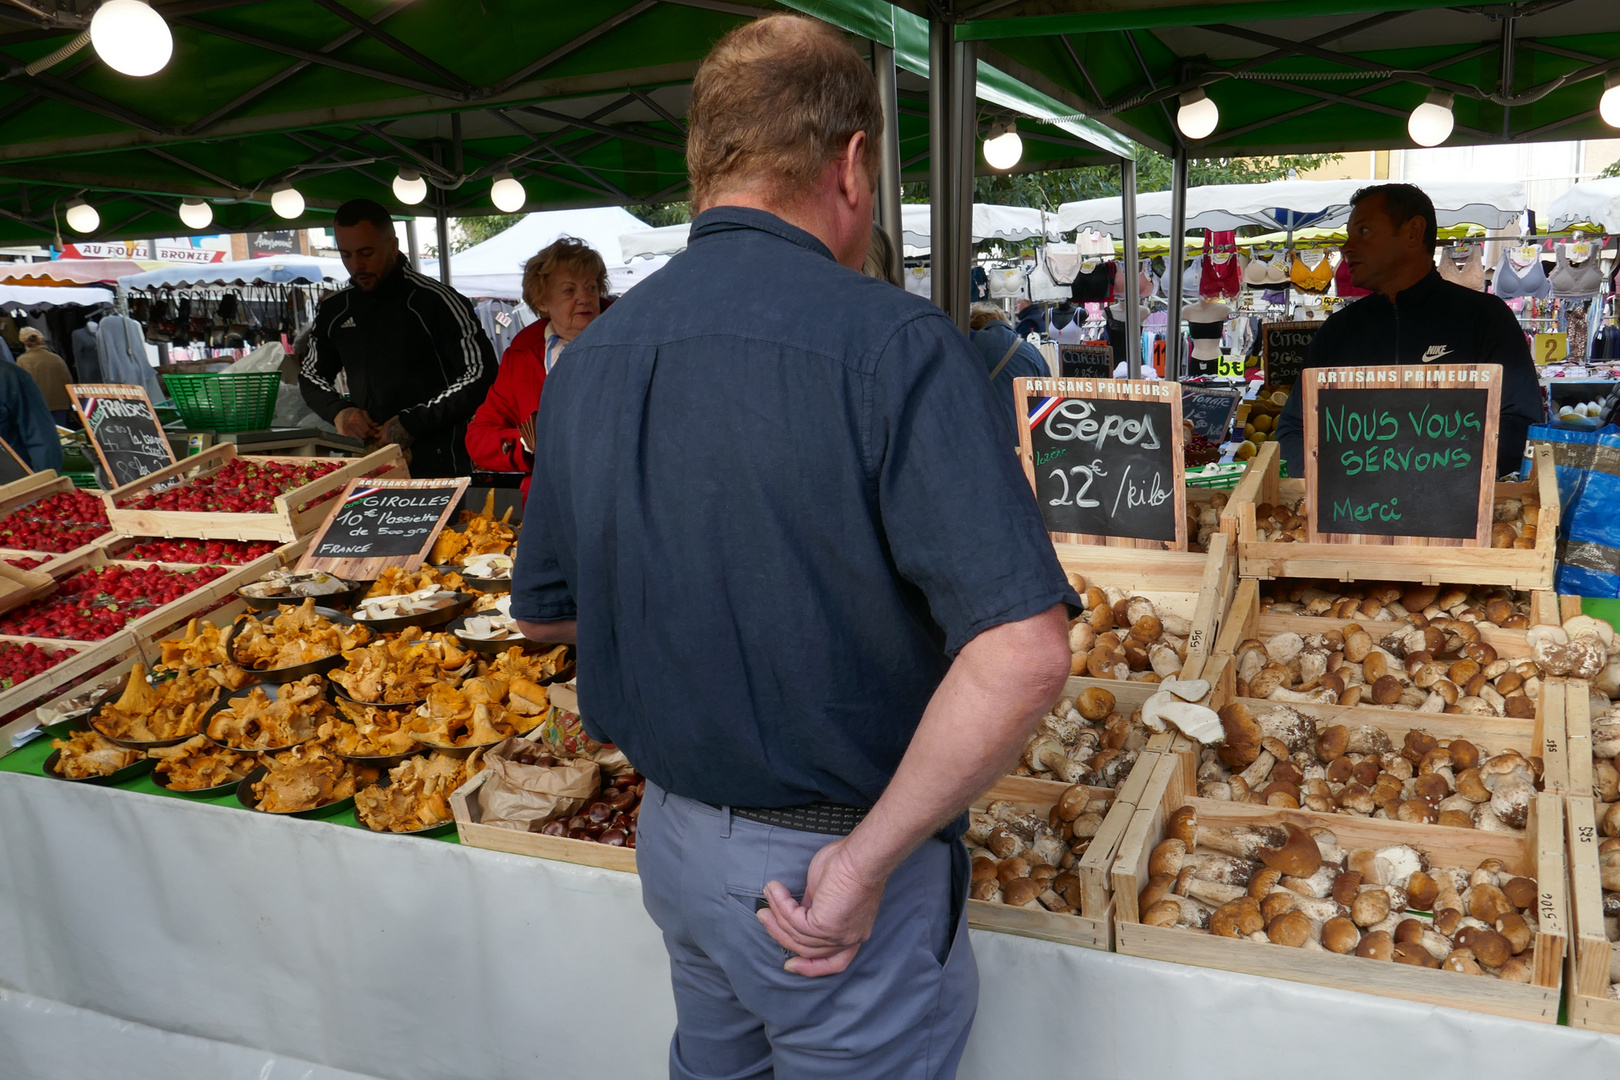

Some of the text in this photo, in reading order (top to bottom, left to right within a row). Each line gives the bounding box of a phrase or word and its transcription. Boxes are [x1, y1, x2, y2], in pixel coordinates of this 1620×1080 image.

[83, 245, 101, 254] AU
[1426, 345, 1447, 355] NIKE
[1545, 339, 1558, 362] 2
[1219, 354, 1244, 376] 5€
[1317, 370, 1491, 383] ARTISANS PRIMEURS
[73, 387, 143, 397] ARTISANS PRIMEURS
[1026, 380, 1170, 396] ARTISANS PRIMEURS
[1325, 403, 1481, 443] NOUS VOUS
[1340, 446, 1471, 475] SERVONS
[410, 479, 461, 487] PRIMEURS
[363, 495, 451, 508] GIROLLES
[1333, 497, 1402, 521] Merci
[350, 527, 369, 537] de
[319, 543, 373, 554] FRANCE
[1190, 630, 1203, 648] 550
